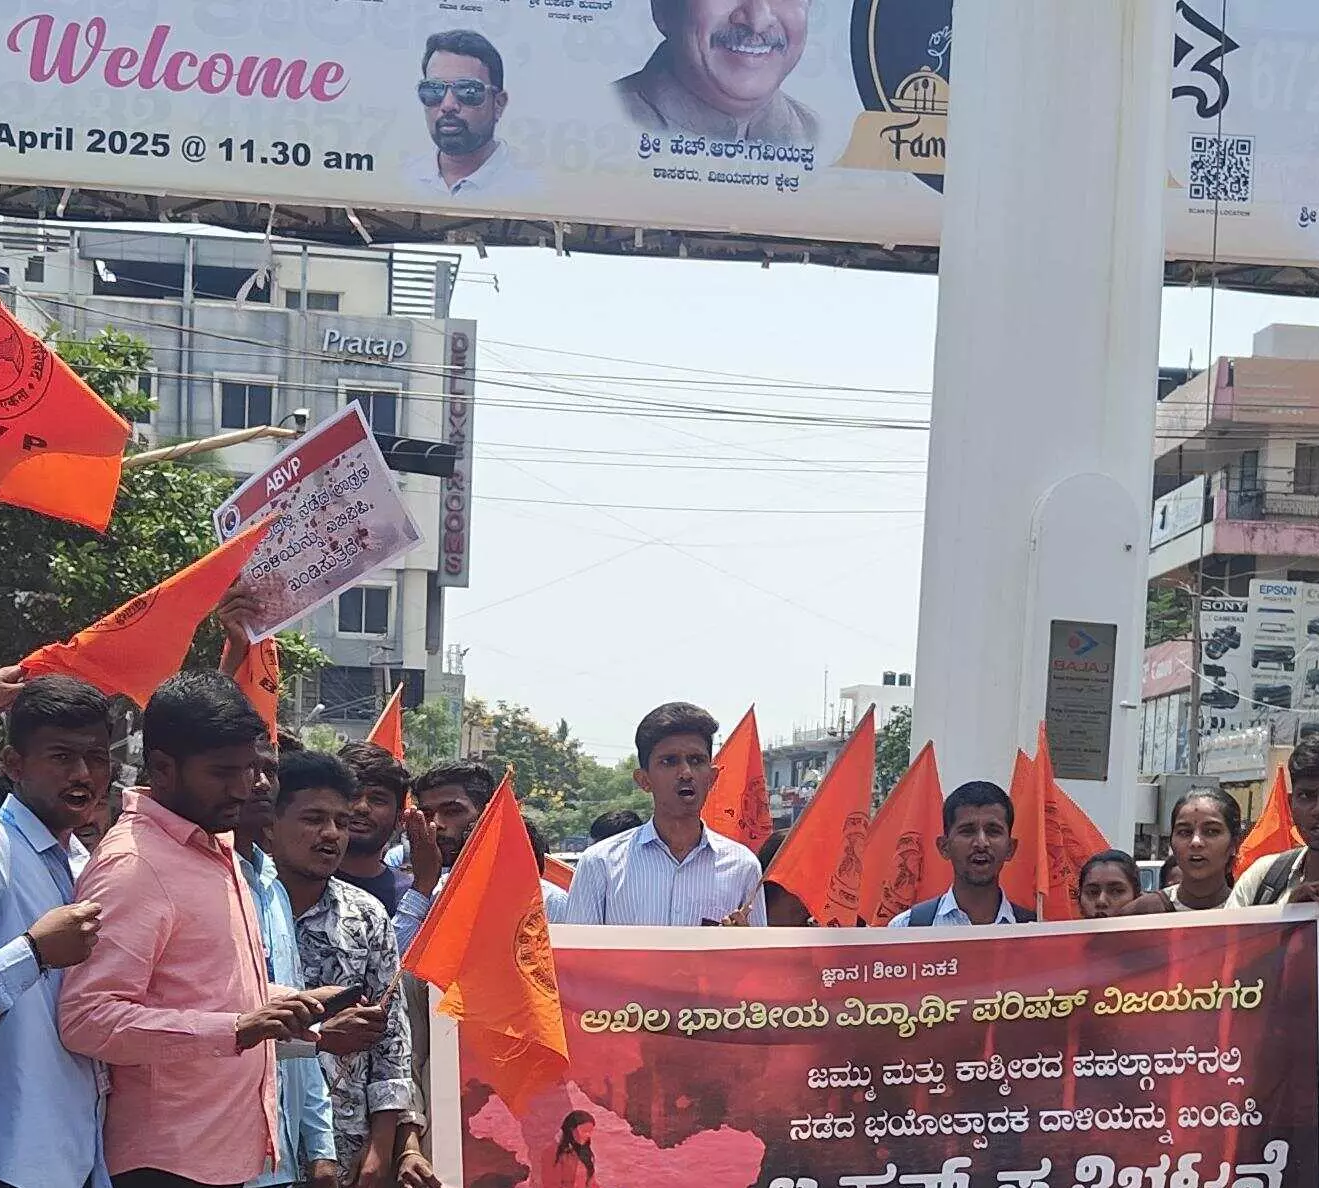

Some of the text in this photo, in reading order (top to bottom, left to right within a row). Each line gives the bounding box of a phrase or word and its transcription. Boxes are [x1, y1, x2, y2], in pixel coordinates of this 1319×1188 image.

[7, 3, 349, 102] Welcome
[86, 130, 171, 158] 2025
[181, 136, 207, 167] @
[218, 138, 312, 167] 11.30
[322, 147, 375, 173] am
[638, 133, 661, 159] ಶ್ರೀ
[708, 171, 769, 186] ವಿಜಯನಗರ
[1298, 206, 1317, 228] ಶ್ರೀ
[321, 328, 408, 362] Pratap
[265, 456, 301, 498] ABVP
[444, 471, 464, 575] ROOMS
[1201, 601, 1247, 612] SONY
[1259, 585, 1297, 596] EPSON
[1053, 659, 1110, 672] BAJAJ
[821, 964, 859, 988] ಜ್ಞಾನ
[873, 961, 907, 980] ಶೀಲ
[921, 958, 958, 976] ಏಕತೆ
[580, 979, 1264, 1038] ಅಖಿಲ ಭಾರತೀಯ ವಿದ್ಯಾರ್ಥಿ ಪರಿಷತ್ ವಿಜಯನಗರ
[807, 1060, 877, 1102] ಜಮ್ಮು
[882, 1057, 947, 1094] ಮತ್ತು
[955, 1051, 1064, 1096] ಕಾಶ್ಮೀರದ
[789, 1098, 1263, 1149] ನಡೆದ ಭಯೋತ್ಪಾದಕ ದಾಳಿಯನ್ನು ಖಂಡಿಸಿ
